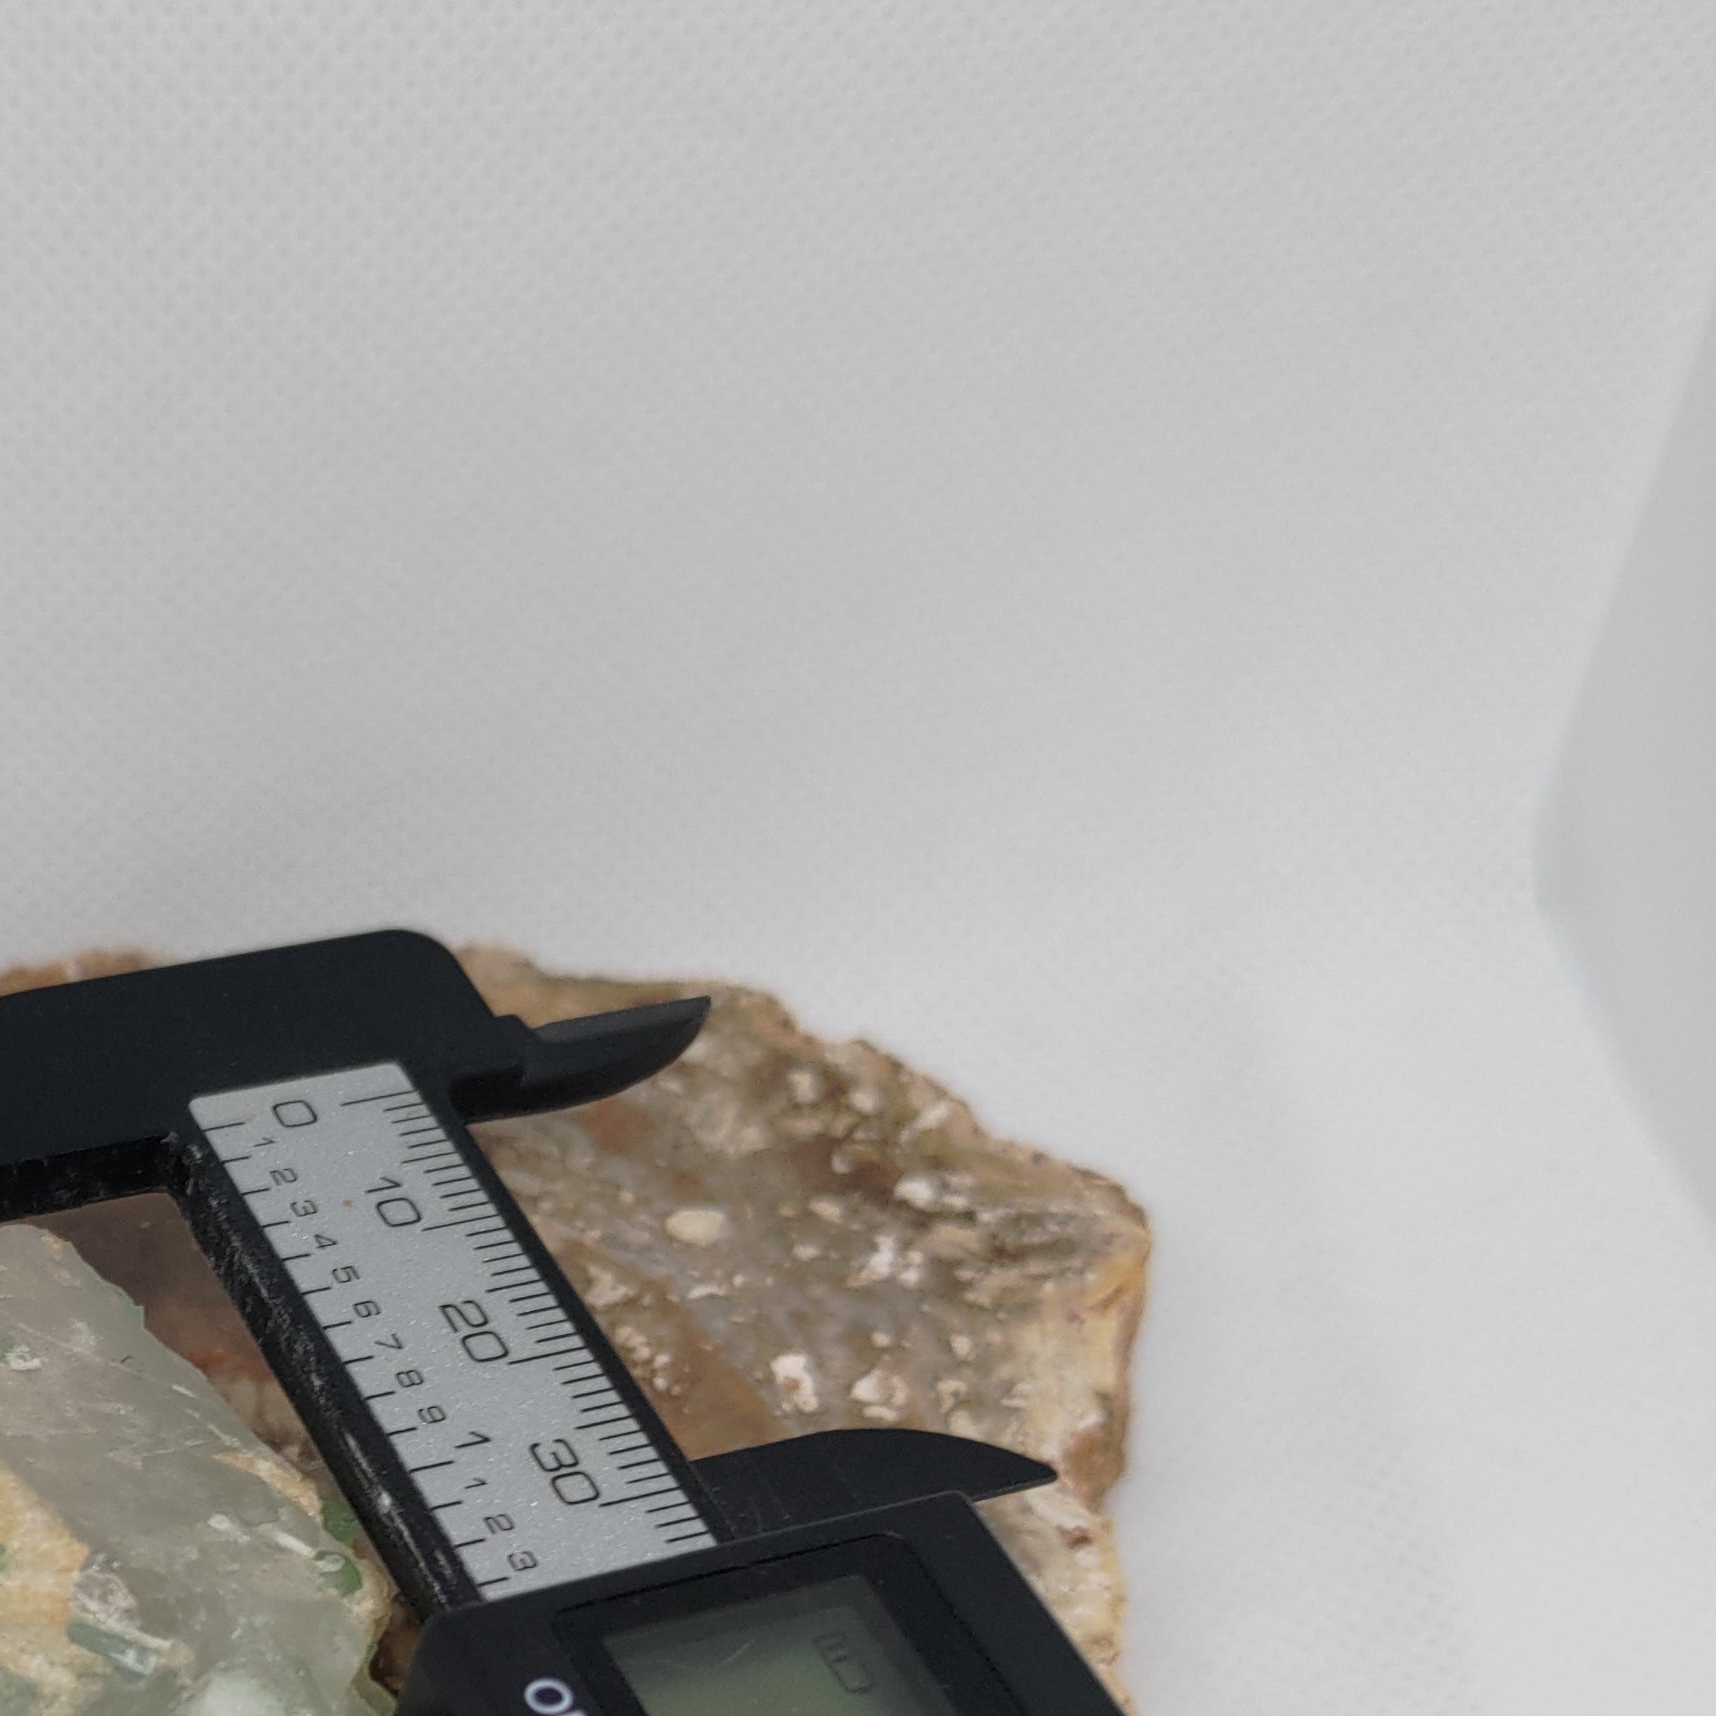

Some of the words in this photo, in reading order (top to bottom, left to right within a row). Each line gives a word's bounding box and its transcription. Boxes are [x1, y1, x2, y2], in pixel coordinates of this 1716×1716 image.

[252, 1135, 277, 1149] 1
[271, 1166, 298, 1186] 2
[291, 1198, 319, 1218] 3
[313, 1232, 338, 1251] 4
[332, 1265, 360, 1284] 5
[353, 1299, 382, 1319] 6
[374, 1332, 403, 1352] 7
[395, 1368, 424, 1388] 8
[417, 1405, 447, 1425] 9
[454, 1430, 492, 1451] 1
[483, 1512, 515, 1534] 2
[507, 1550, 538, 1572] 3
[272, 1099, 318, 1128] 0
[365, 1176, 422, 1228] 10
[438, 1300, 509, 1363] 20
[528, 1438, 601, 1506] 30
